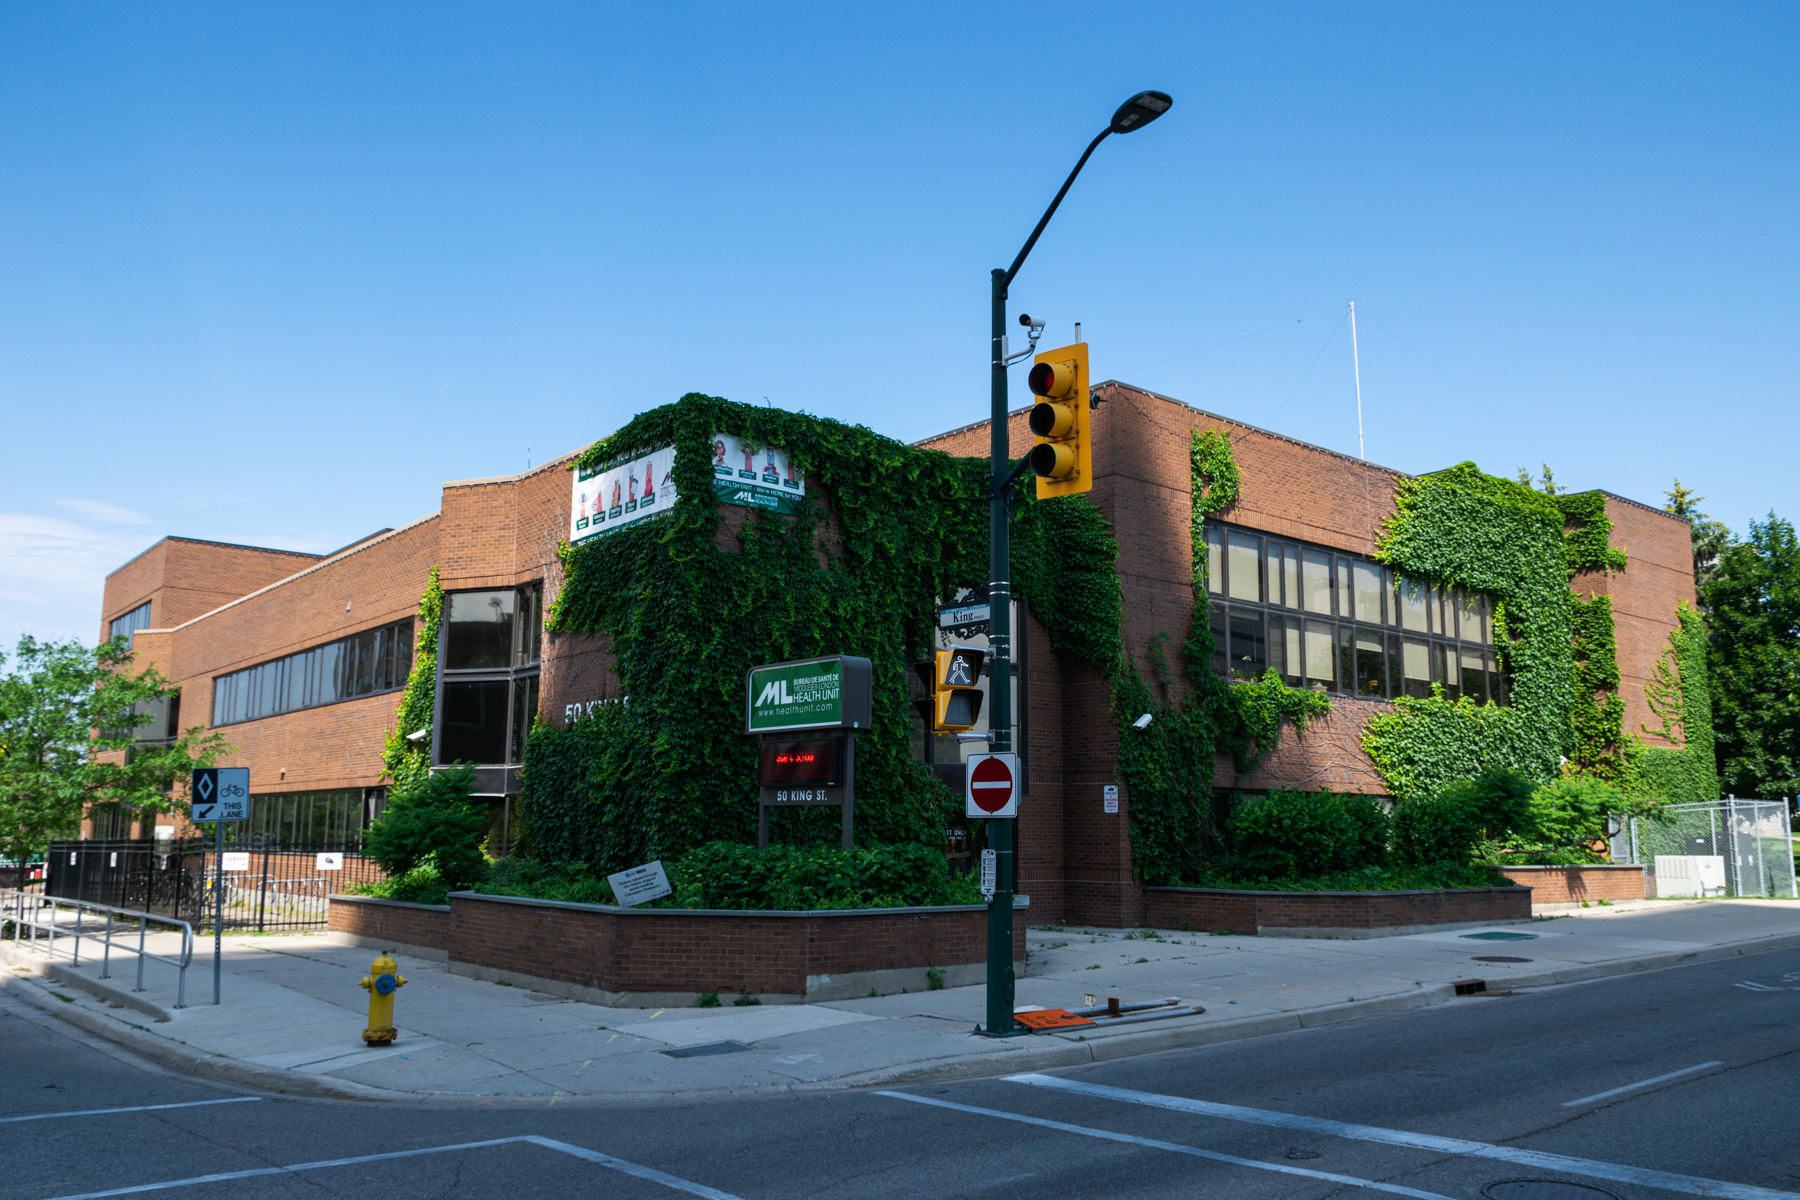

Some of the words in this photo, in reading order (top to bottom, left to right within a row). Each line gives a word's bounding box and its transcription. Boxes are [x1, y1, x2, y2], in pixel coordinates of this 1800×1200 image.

[719, 480, 739, 489] HEALTH
[740, 483, 753, 491] UNIT
[756, 486, 770, 495] We're
[771, 489, 784, 497] HERE
[791, 493, 802, 501] YOU
[953, 612, 974, 623] King
[793, 677, 811, 685] BUREAU
[818, 674, 832, 682] SANTÉ
[832, 673, 839, 681] DE
[793, 681, 839, 692] MIDDLESEX-LONDON
[754, 680, 793, 707] ML
[793, 690, 821, 703] HEALTH
[822, 688, 839, 701] UNIT
[564, 702, 582, 723] 50
[758, 702, 833, 717] www.healthunit.com
[777, 790, 788, 801] 50
[791, 790, 813, 801] KING
[816, 789, 828, 801] ST.
[223, 802, 242, 810] THIS
[220, 810, 243, 819] LANE
